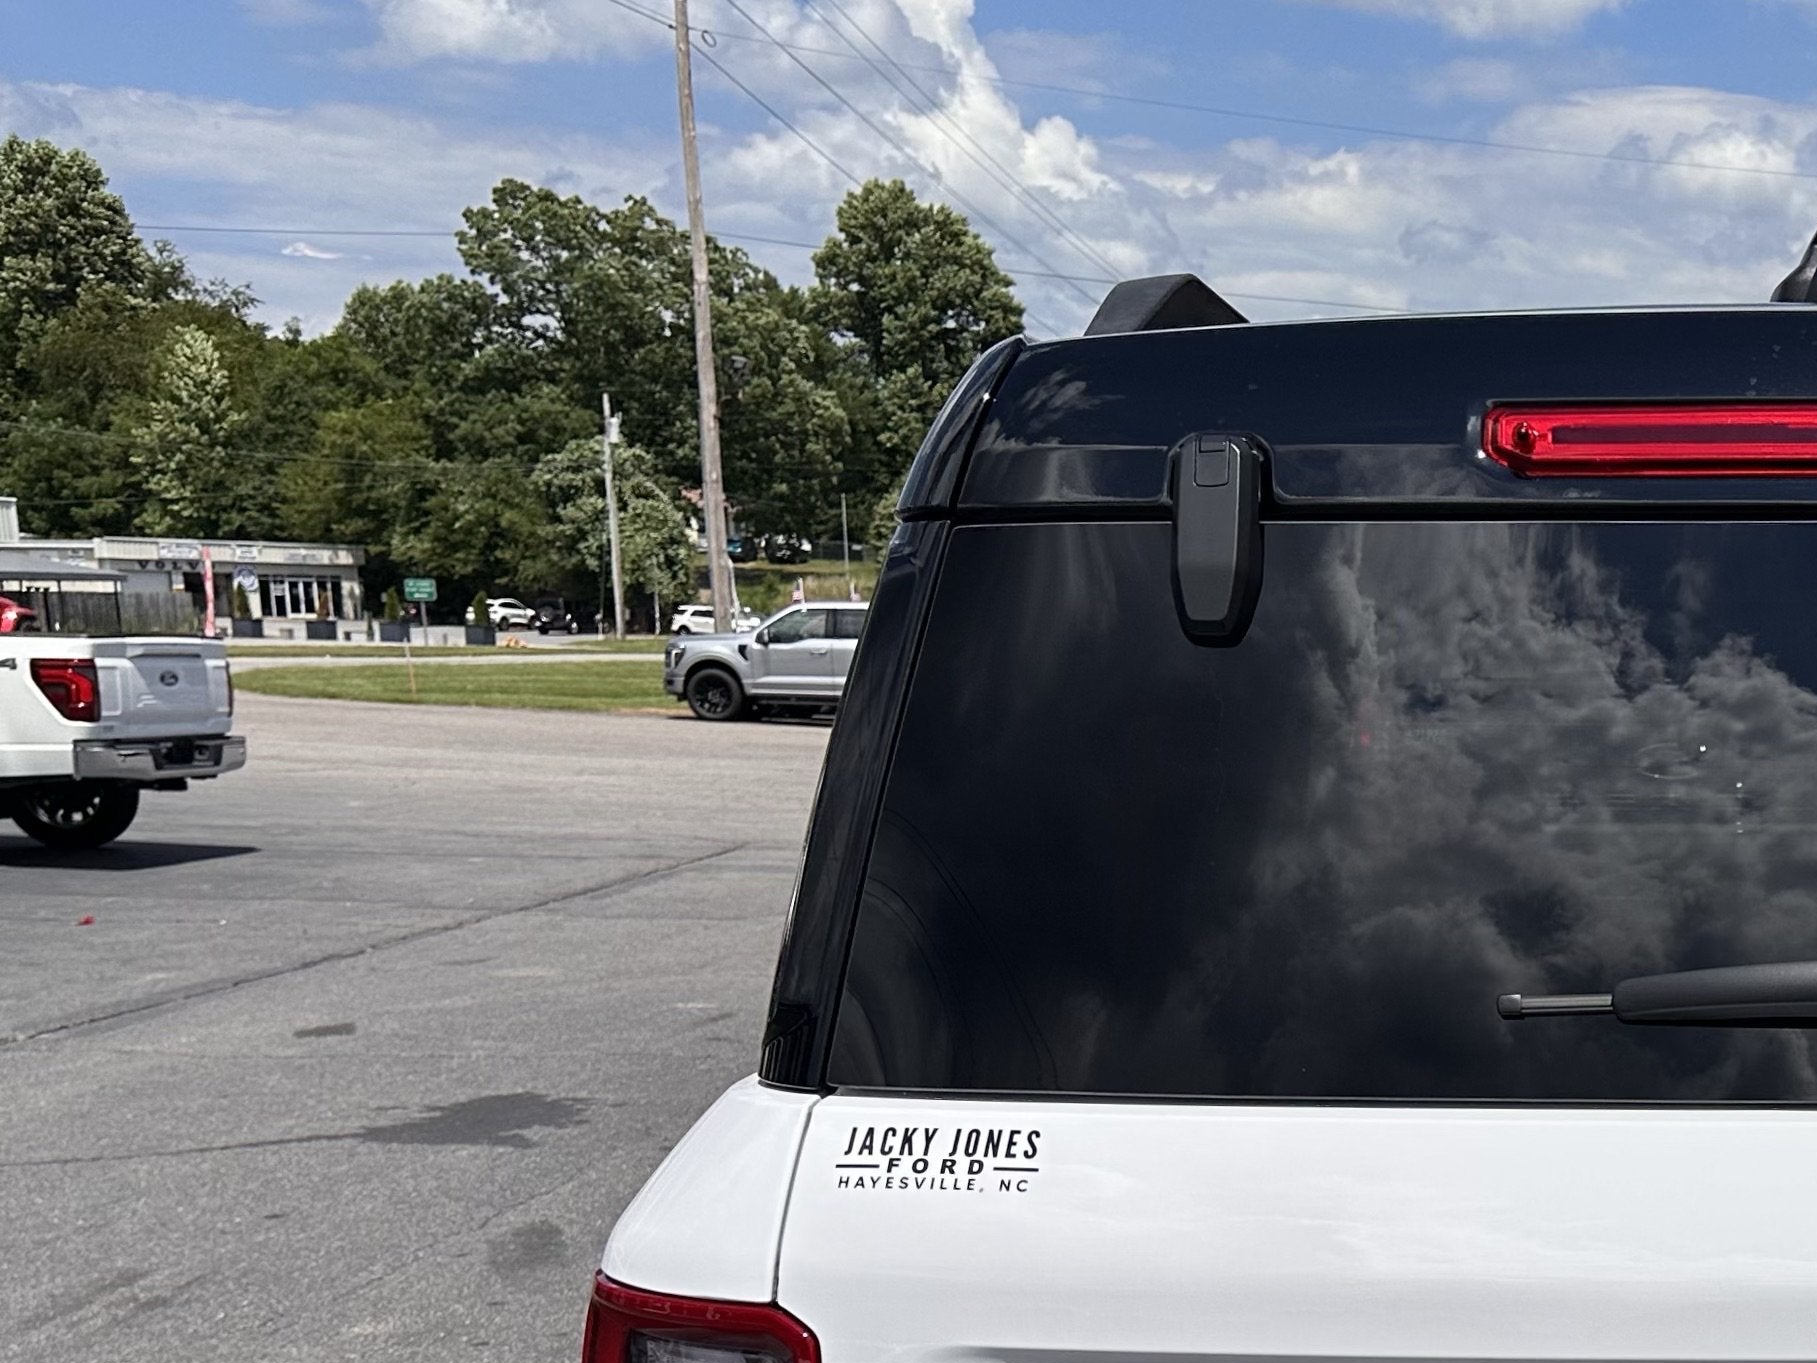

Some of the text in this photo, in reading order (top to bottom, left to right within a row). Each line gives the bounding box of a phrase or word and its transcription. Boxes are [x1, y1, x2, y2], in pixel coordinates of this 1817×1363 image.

[843, 1126, 1041, 1159] JACKY JONES
[886, 1158, 984, 1175] FORD
[837, 1175, 1029, 1193] HAYESVILLE, NC
